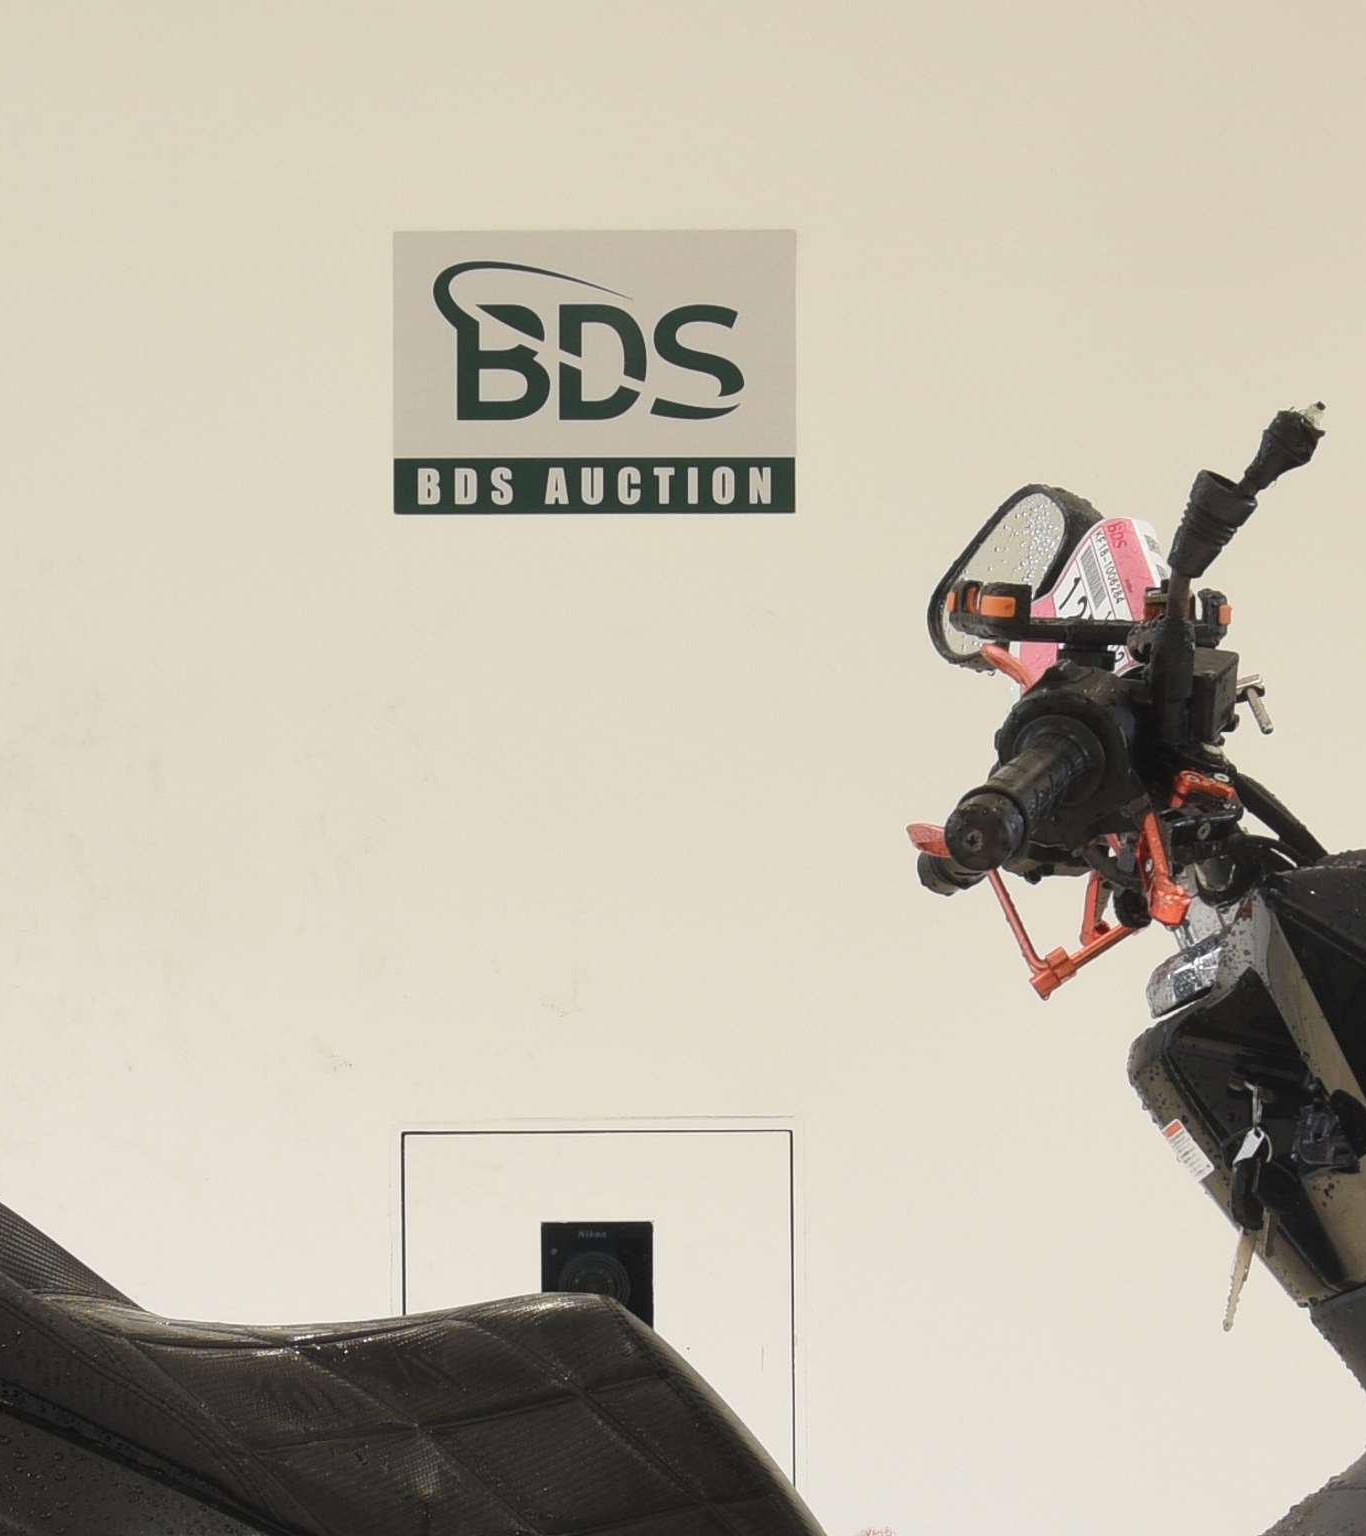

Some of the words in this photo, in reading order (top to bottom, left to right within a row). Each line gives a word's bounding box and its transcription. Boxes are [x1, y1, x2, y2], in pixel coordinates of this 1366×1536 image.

[433, 261, 746, 421] BDS
[417, 466, 514, 506] BDS
[544, 466, 772, 506] AUCTION
[578, 1229, 607, 1239] Nikon
